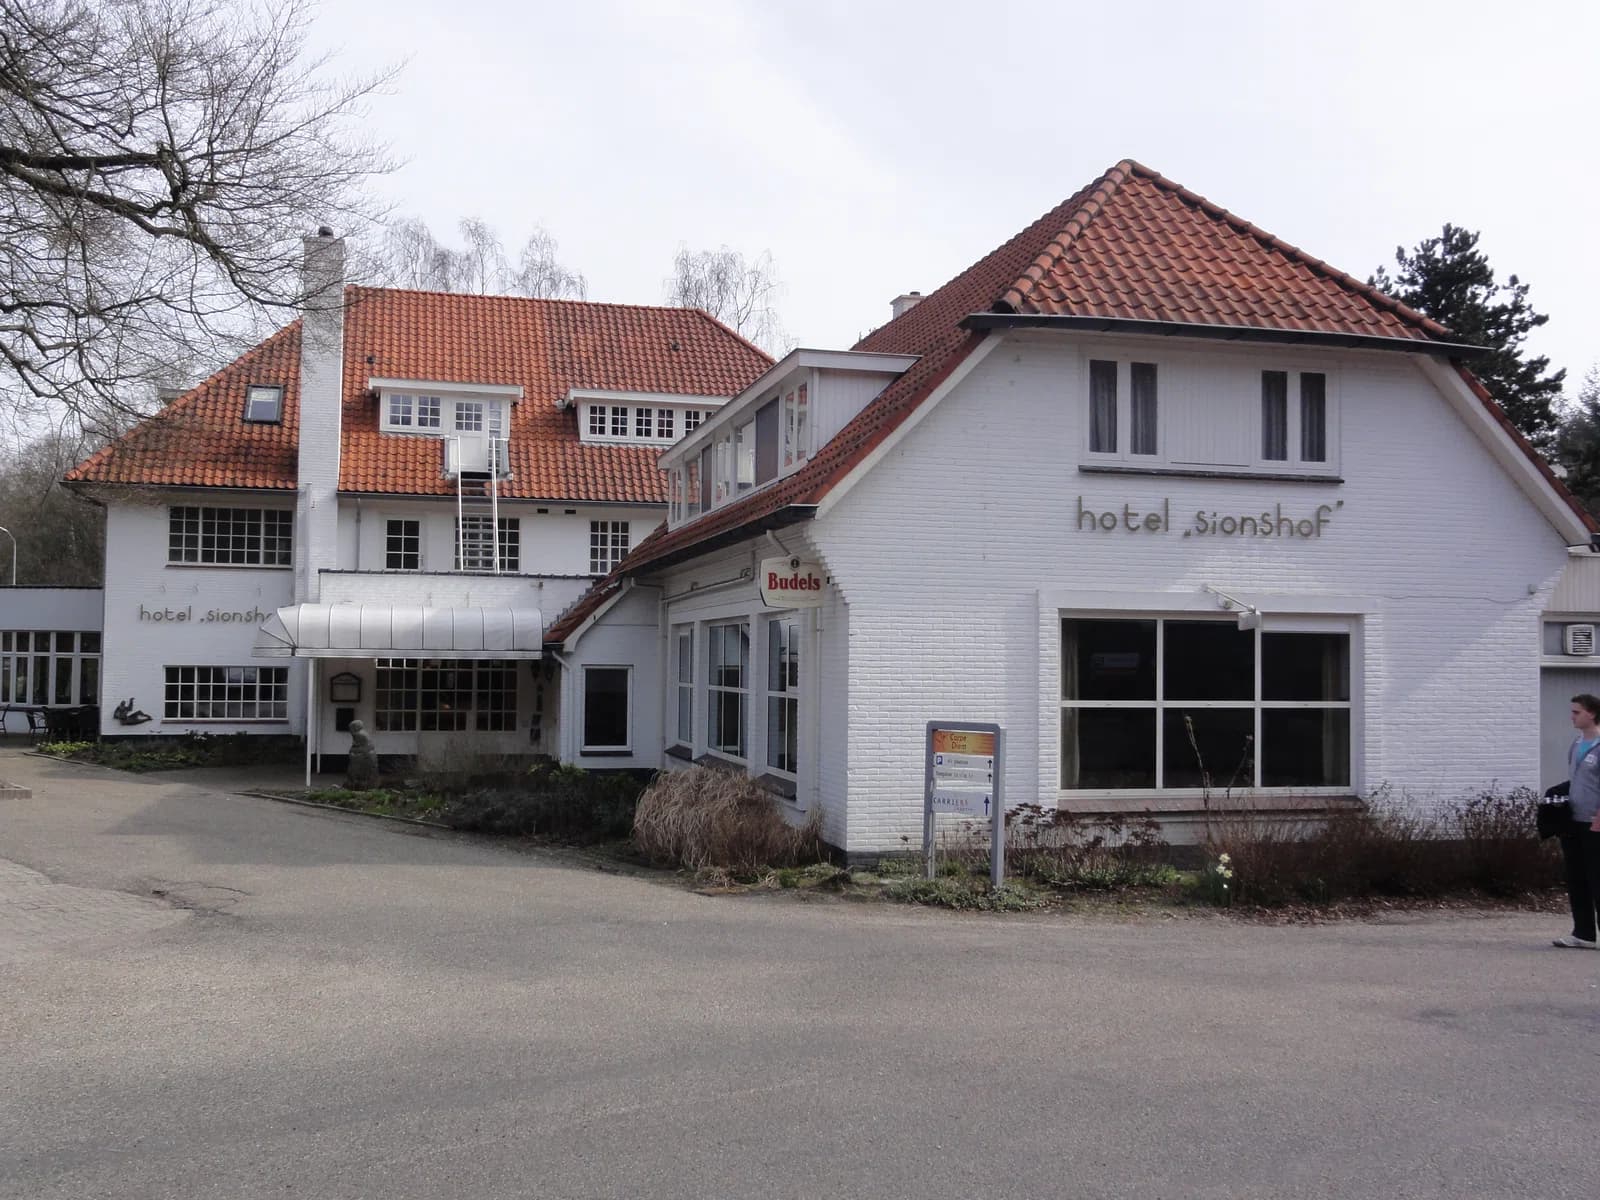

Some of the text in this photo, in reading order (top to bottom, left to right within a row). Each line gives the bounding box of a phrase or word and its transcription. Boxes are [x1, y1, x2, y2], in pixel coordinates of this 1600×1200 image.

[1077, 495, 1169, 532] hotel
[768, 572, 821, 591] Budels
[139, 603, 192, 622] hotel
